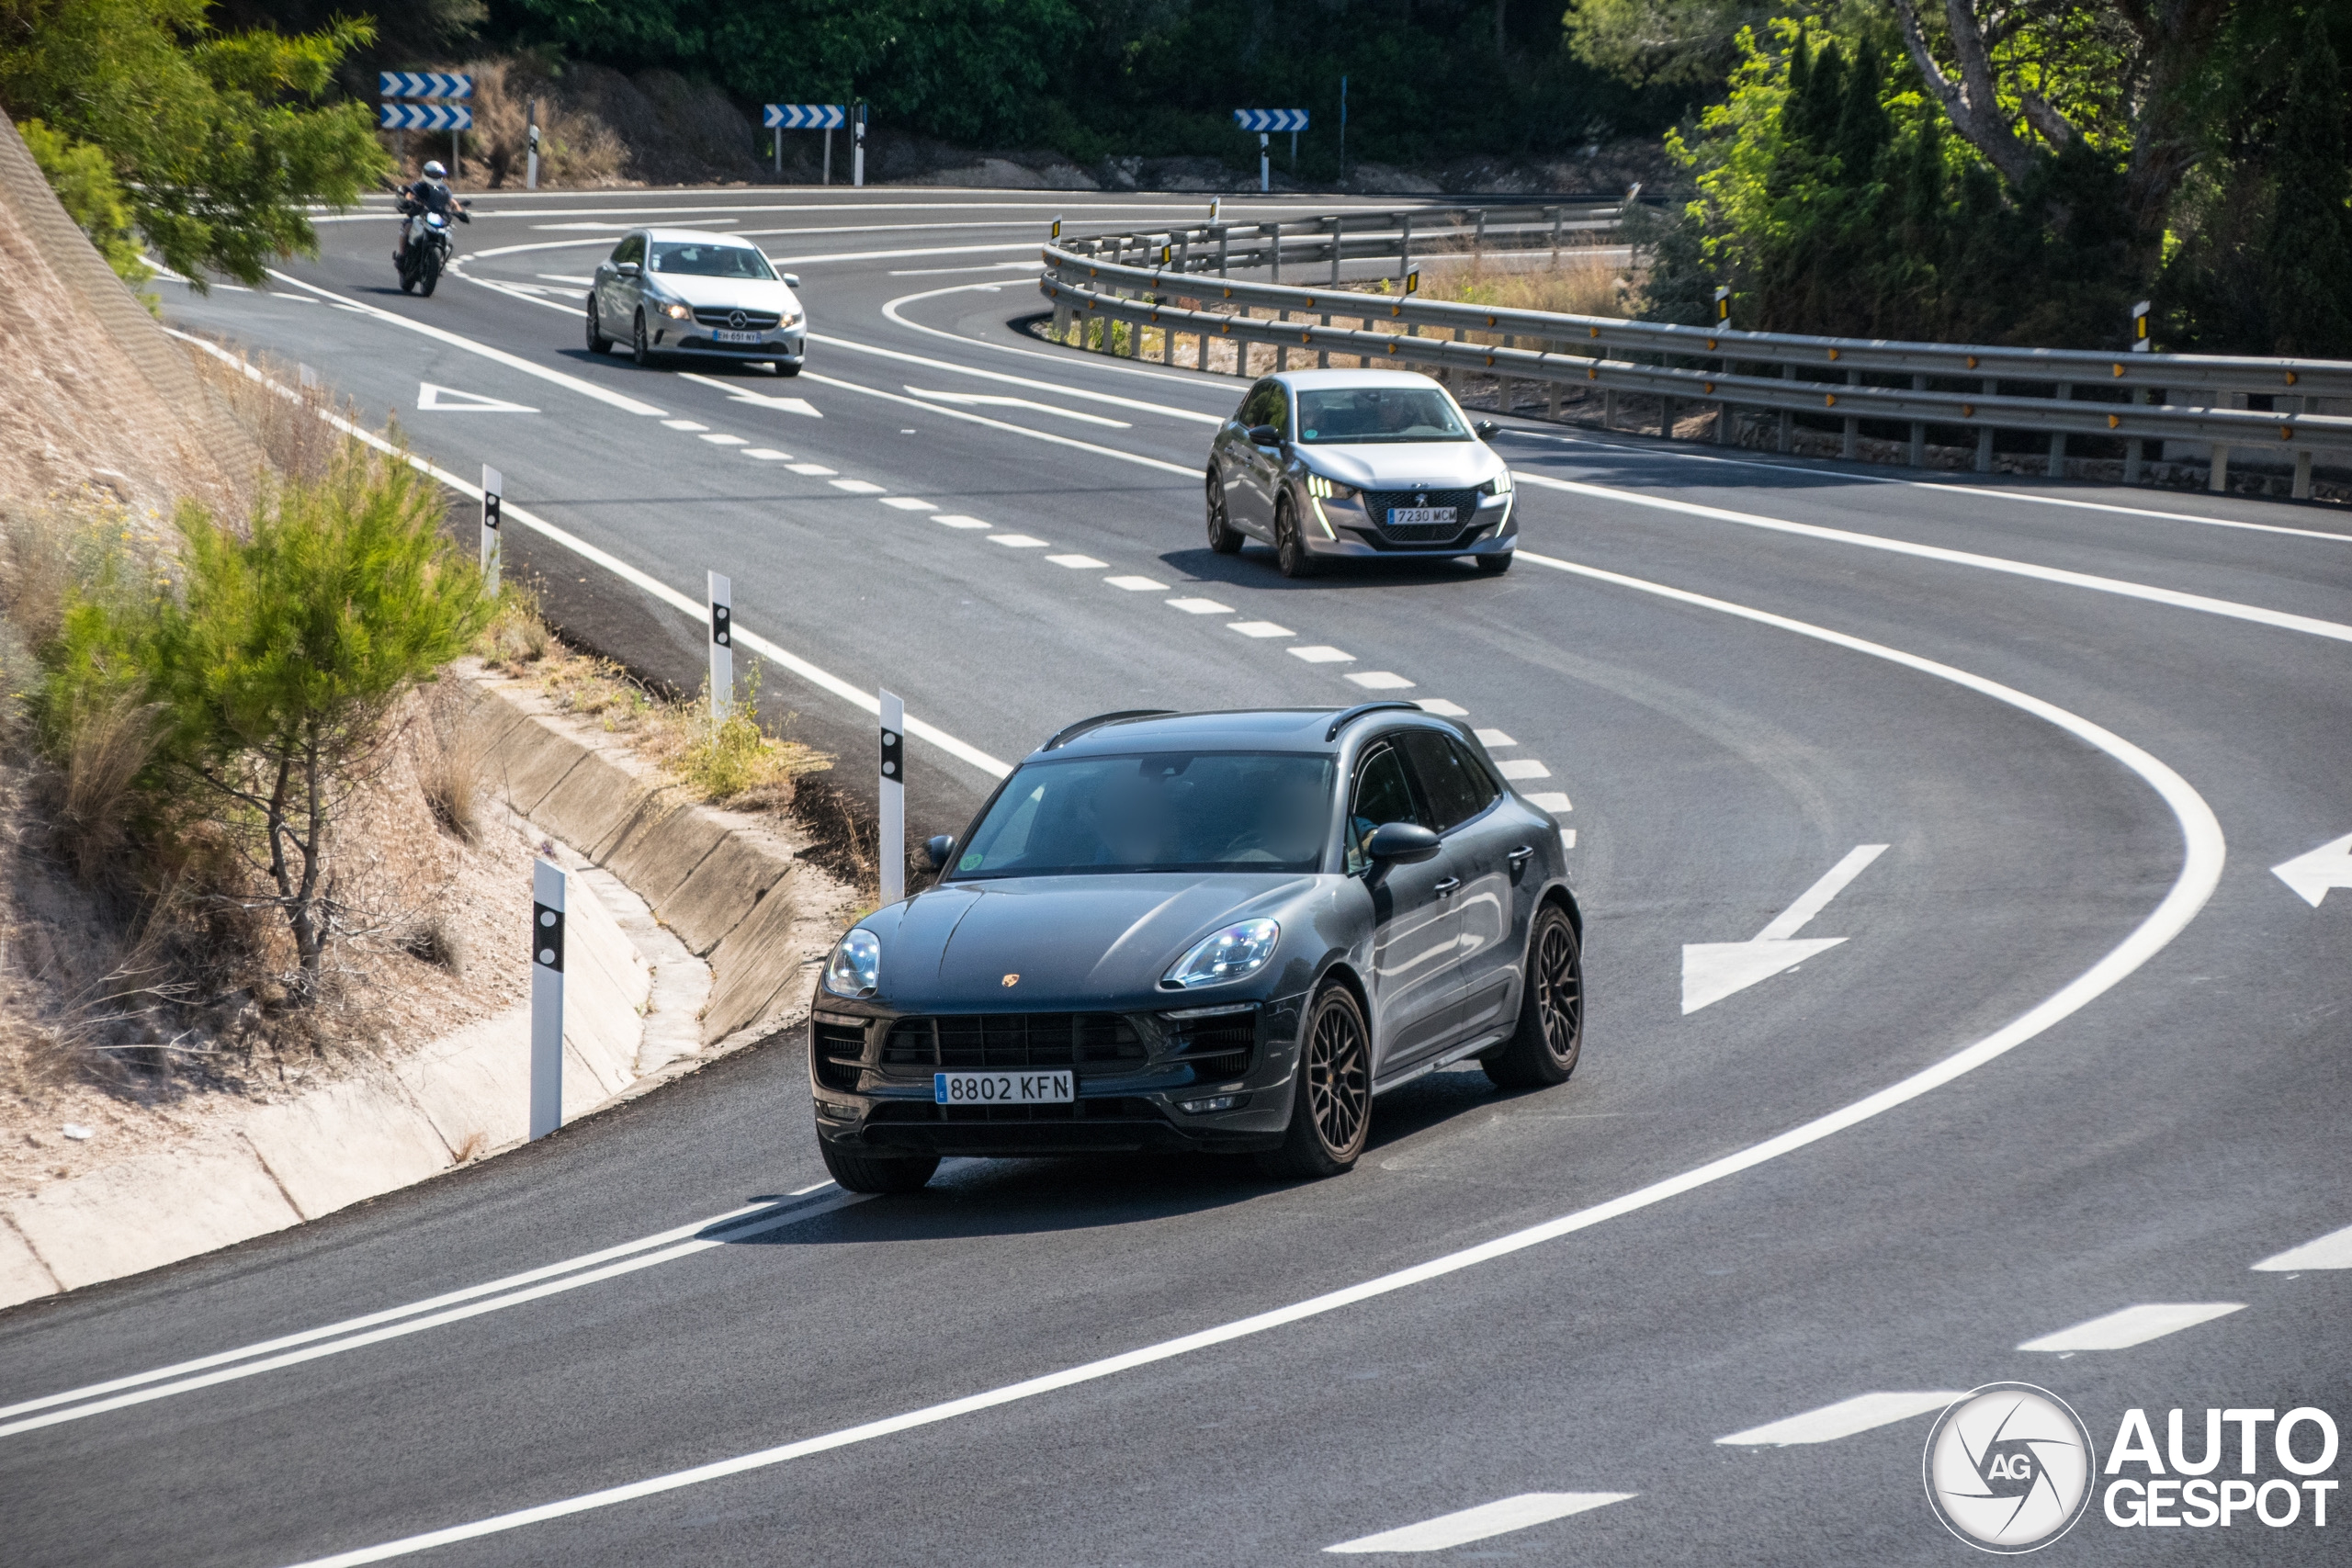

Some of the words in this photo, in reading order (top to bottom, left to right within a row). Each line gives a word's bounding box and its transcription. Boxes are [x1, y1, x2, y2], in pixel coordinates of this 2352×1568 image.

[1398, 510, 1430, 522] 7230
[1433, 509, 1456, 521] MCM
[951, 1077, 1012, 1100] 8802
[1021, 1076, 1069, 1099] KFN
